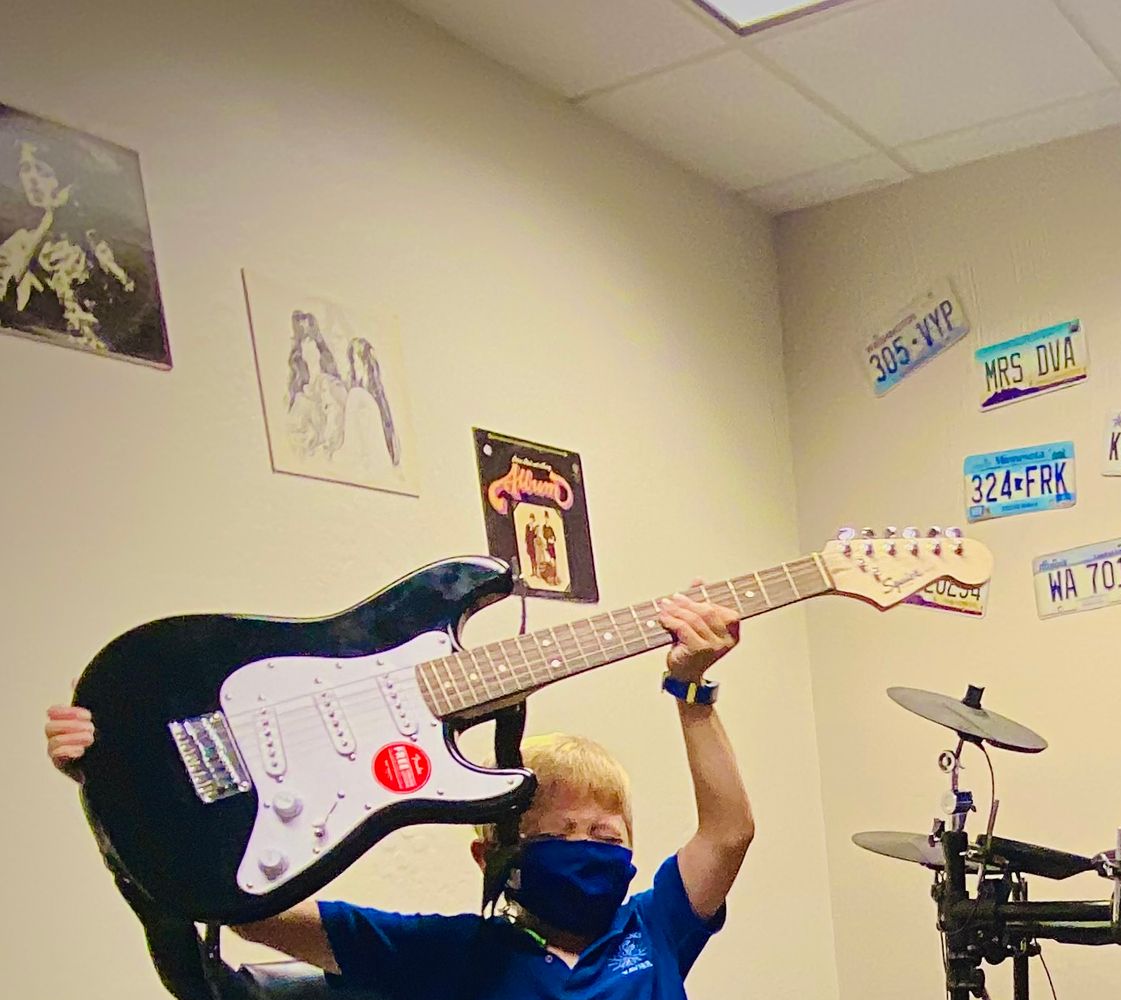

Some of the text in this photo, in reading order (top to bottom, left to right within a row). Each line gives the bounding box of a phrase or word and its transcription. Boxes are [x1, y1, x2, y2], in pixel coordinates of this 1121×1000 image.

[984, 336, 1076, 392] MRS DVA
[971, 461, 1068, 503] 324 FRK
[1048, 568, 1078, 602] WA
